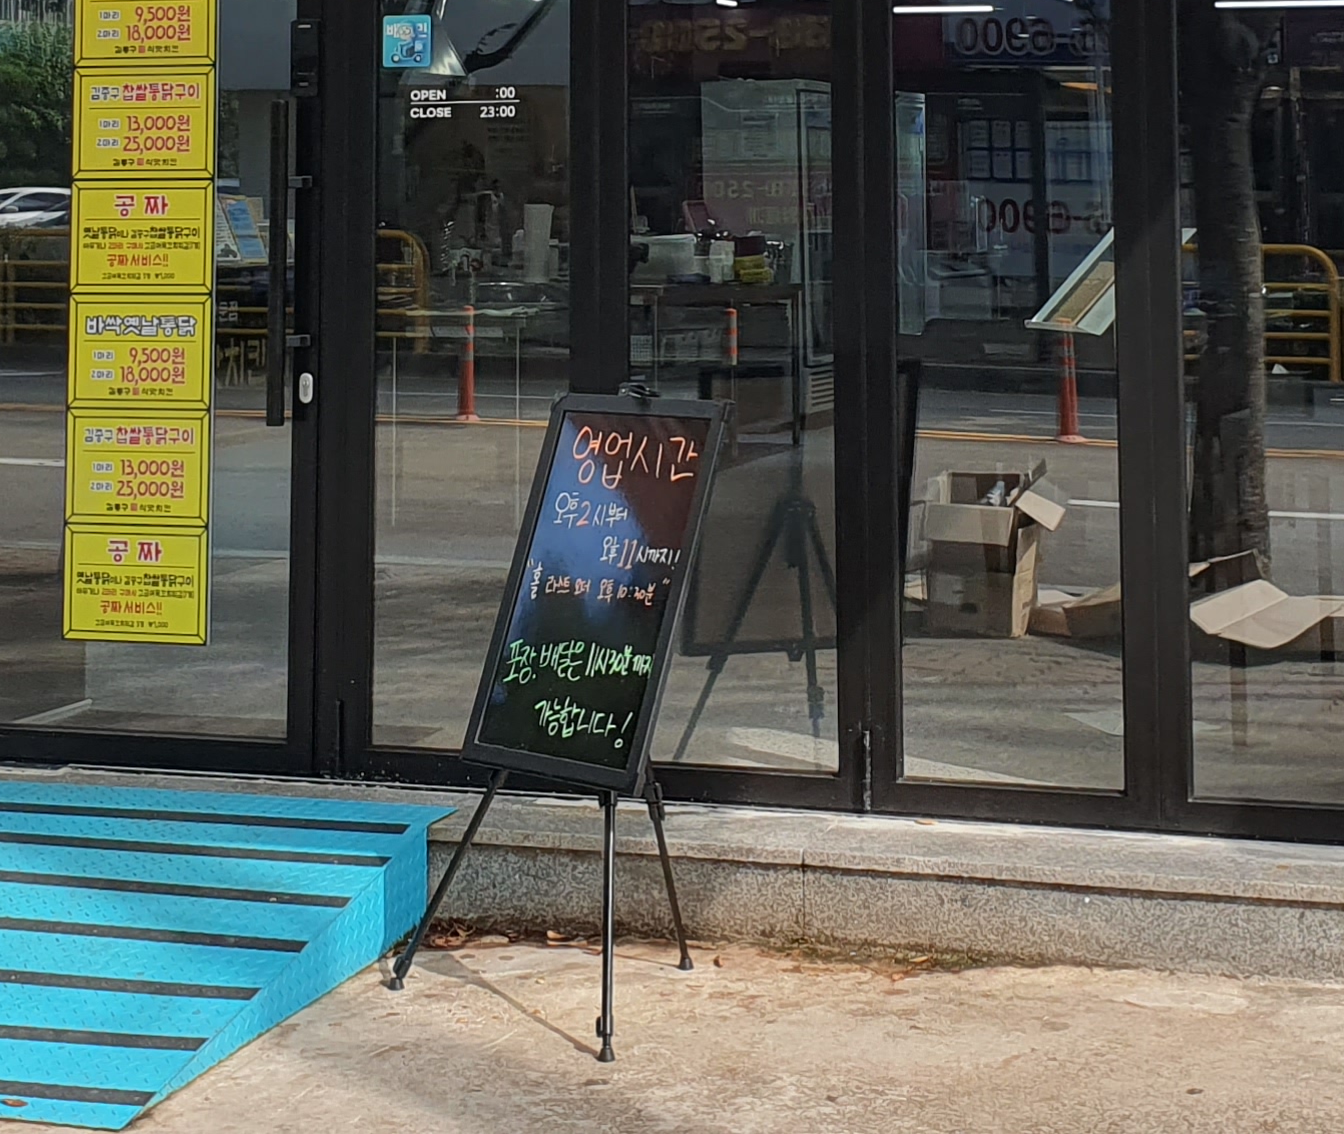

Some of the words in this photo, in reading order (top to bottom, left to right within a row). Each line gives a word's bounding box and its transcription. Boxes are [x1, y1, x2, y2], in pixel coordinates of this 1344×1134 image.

[134, 5, 191, 26] 9,500원
[126, 23, 191, 44] 18,000원
[90, 85, 121, 103] 김종구
[122, 82, 201, 104] 찹쌀통닭구이
[410, 89, 447, 100] OPEN
[410, 107, 452, 118] CLOSE
[479, 105, 516, 118] 23:00
[126, 114, 191, 135] 13,000원
[123, 134, 191, 155] 25,000원
[84, 314, 198, 338] 바싹옛날통닭
[128, 347, 186, 367] 9,500원
[119, 365, 186, 386] 18,000원
[83, 427, 115, 445] 김종구
[116, 425, 196, 446] 찹쌀통닭구이
[572, 425, 699, 490] 영업시간
[119, 458, 185, 480] 13,000원
[116, 479, 185, 501] 25,000원
